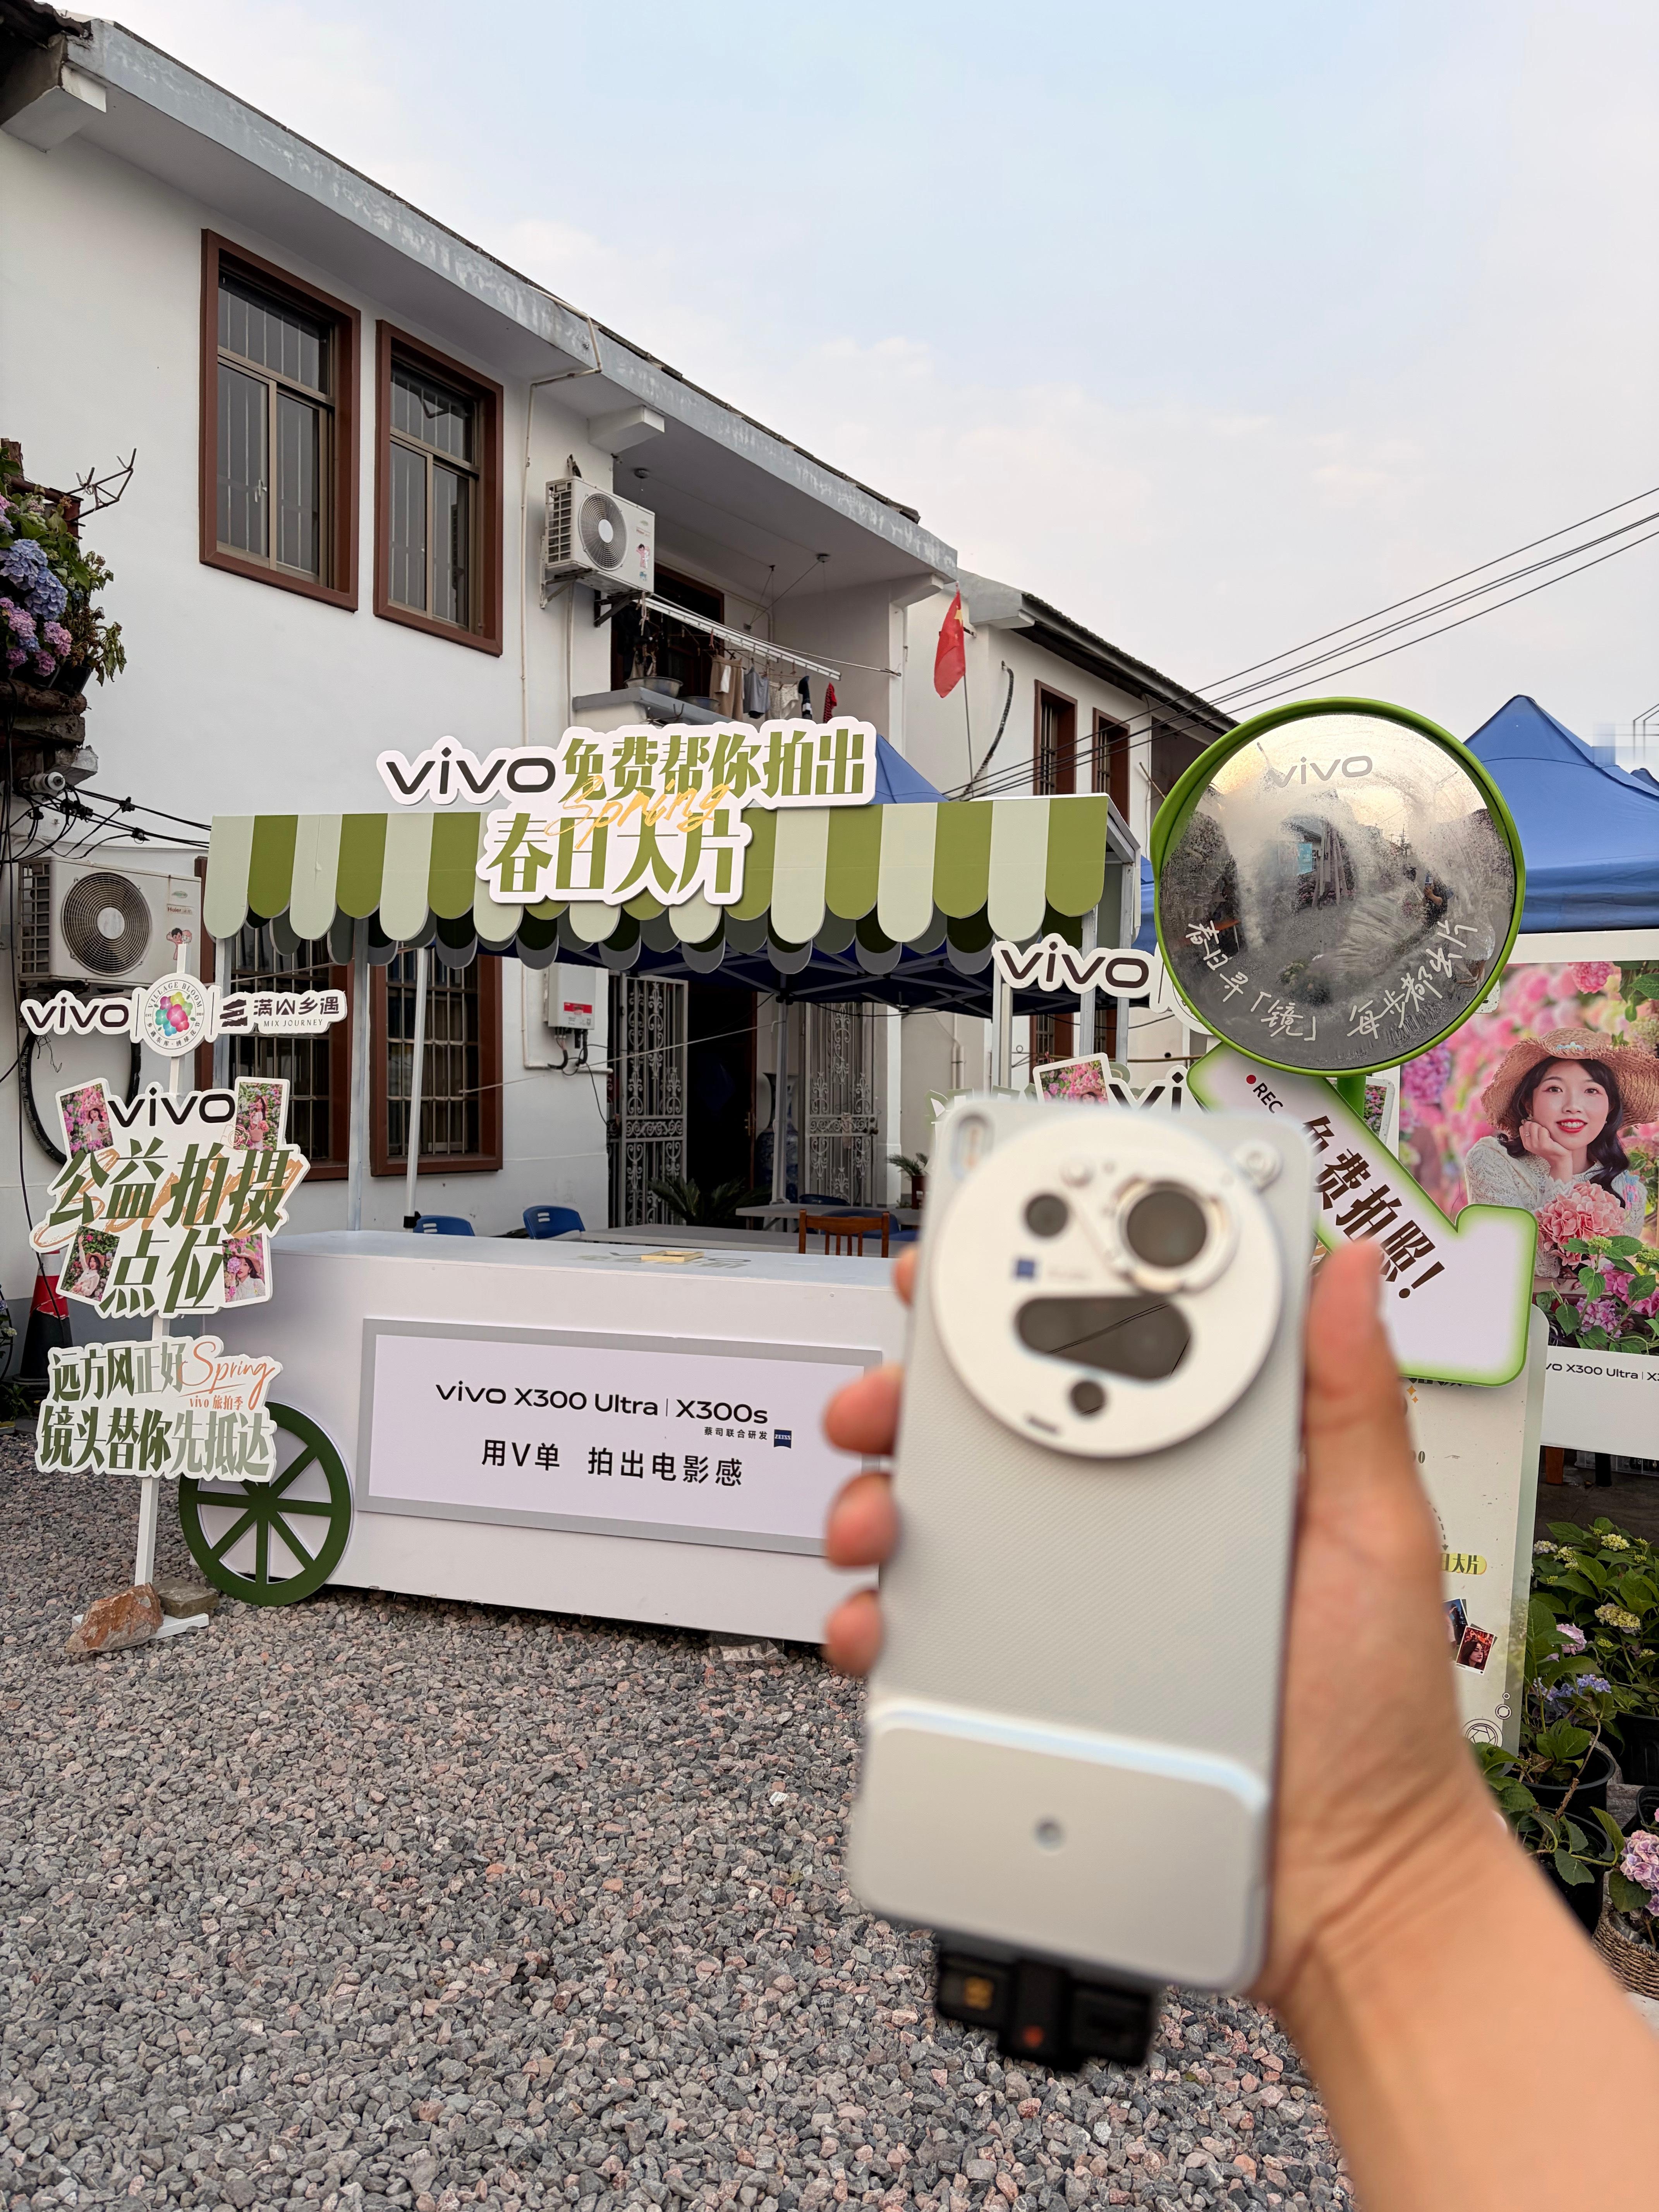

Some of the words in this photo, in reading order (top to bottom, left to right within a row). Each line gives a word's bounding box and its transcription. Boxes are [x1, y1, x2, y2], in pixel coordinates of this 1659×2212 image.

[386, 747, 556, 795] vivo
[559, 728, 866, 804] 免费帮你拍出
[1267, 756, 1372, 788] vivo
[544, 775, 730, 849] Spring
[486, 809, 741, 895] 春日大片
[1000, 941, 1149, 988] vivo
[27, 998, 129, 1028] vivo
[148, 982, 178, 1008] VILLAGE
[182, 983, 202, 1008] BLOOM
[283, 1019, 323, 1027] JOURNEY
[108, 1087, 235, 1127] vivo
[1253, 1082, 1283, 1114] REC
[50, 1137, 294, 1236] 公益拍摄
[99, 1228, 225, 1314] 点位
[52, 1342, 187, 1401] 远方风正好
[177, 1341, 274, 1410] Spring
[1566, 1364, 1602, 1375] X300
[1606, 1368, 1638, 1379] Ultra
[1647, 1372, 1659, 1381] X
[189, 1395, 209, 1408] vivo
[213, 1395, 243, 1410] 旅拍季
[436, 1381, 507, 1405] vivo
[514, 1388, 587, 1410] X300
[594, 1394, 659, 1416] Ultra
[676, 1399, 768, 1424] X300s
[40, 1405, 271, 1476] 镜头替你先抵达
[704, 1427, 768, 1440] 蔡司联合研发
[482, 1439, 560, 1472] 用V单
[588, 1447, 742, 1487] 拍出电影感
